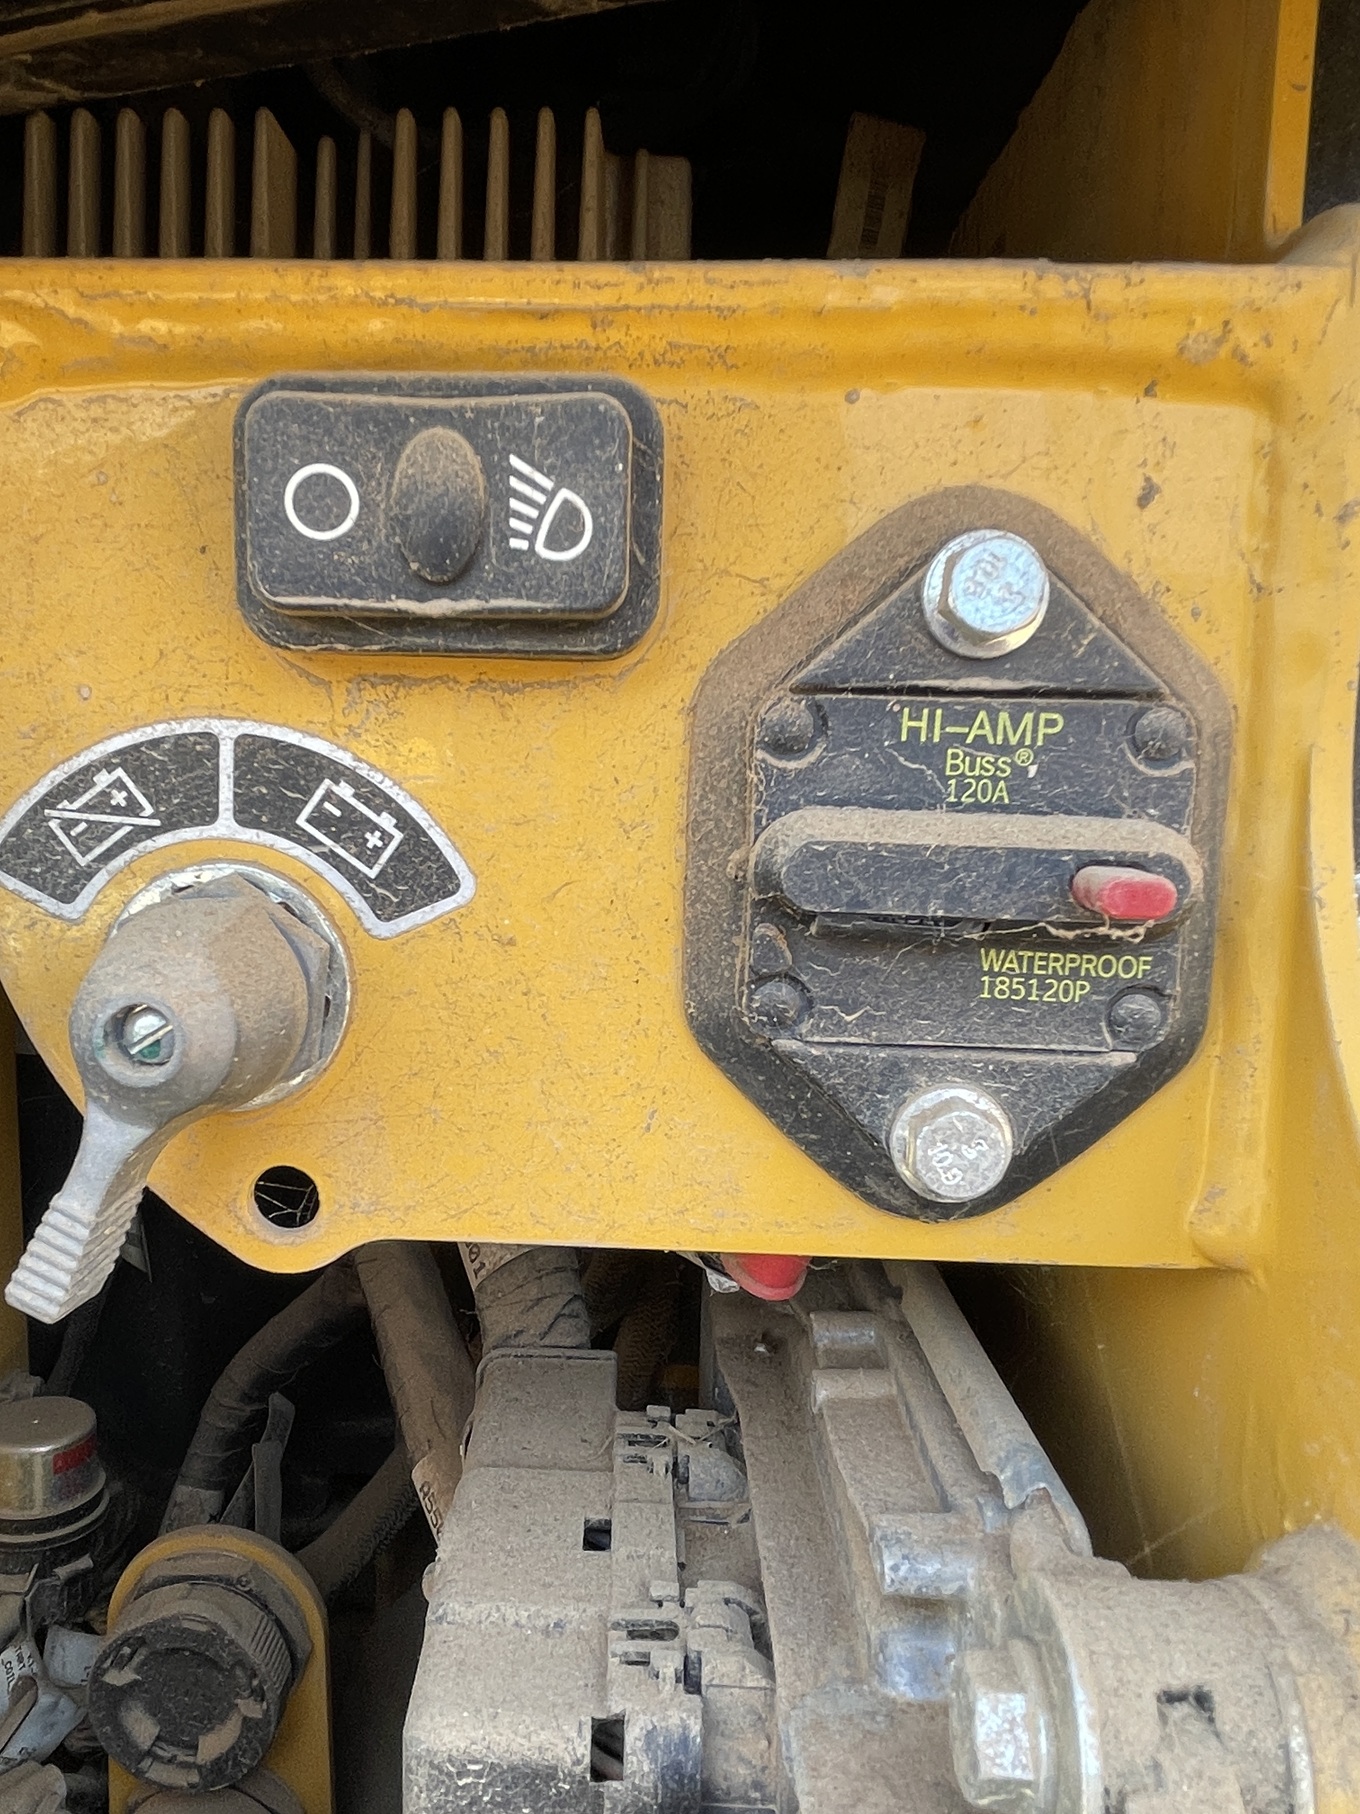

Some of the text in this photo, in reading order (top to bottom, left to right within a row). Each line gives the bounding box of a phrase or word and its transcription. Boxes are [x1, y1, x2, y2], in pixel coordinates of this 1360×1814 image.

[901, 706, 1064, 746] HI-AMP
[946, 778, 1010, 804] 120A
[980, 948, 1153, 979] WATERPROOF
[980, 976, 1090, 1003] 185120P
